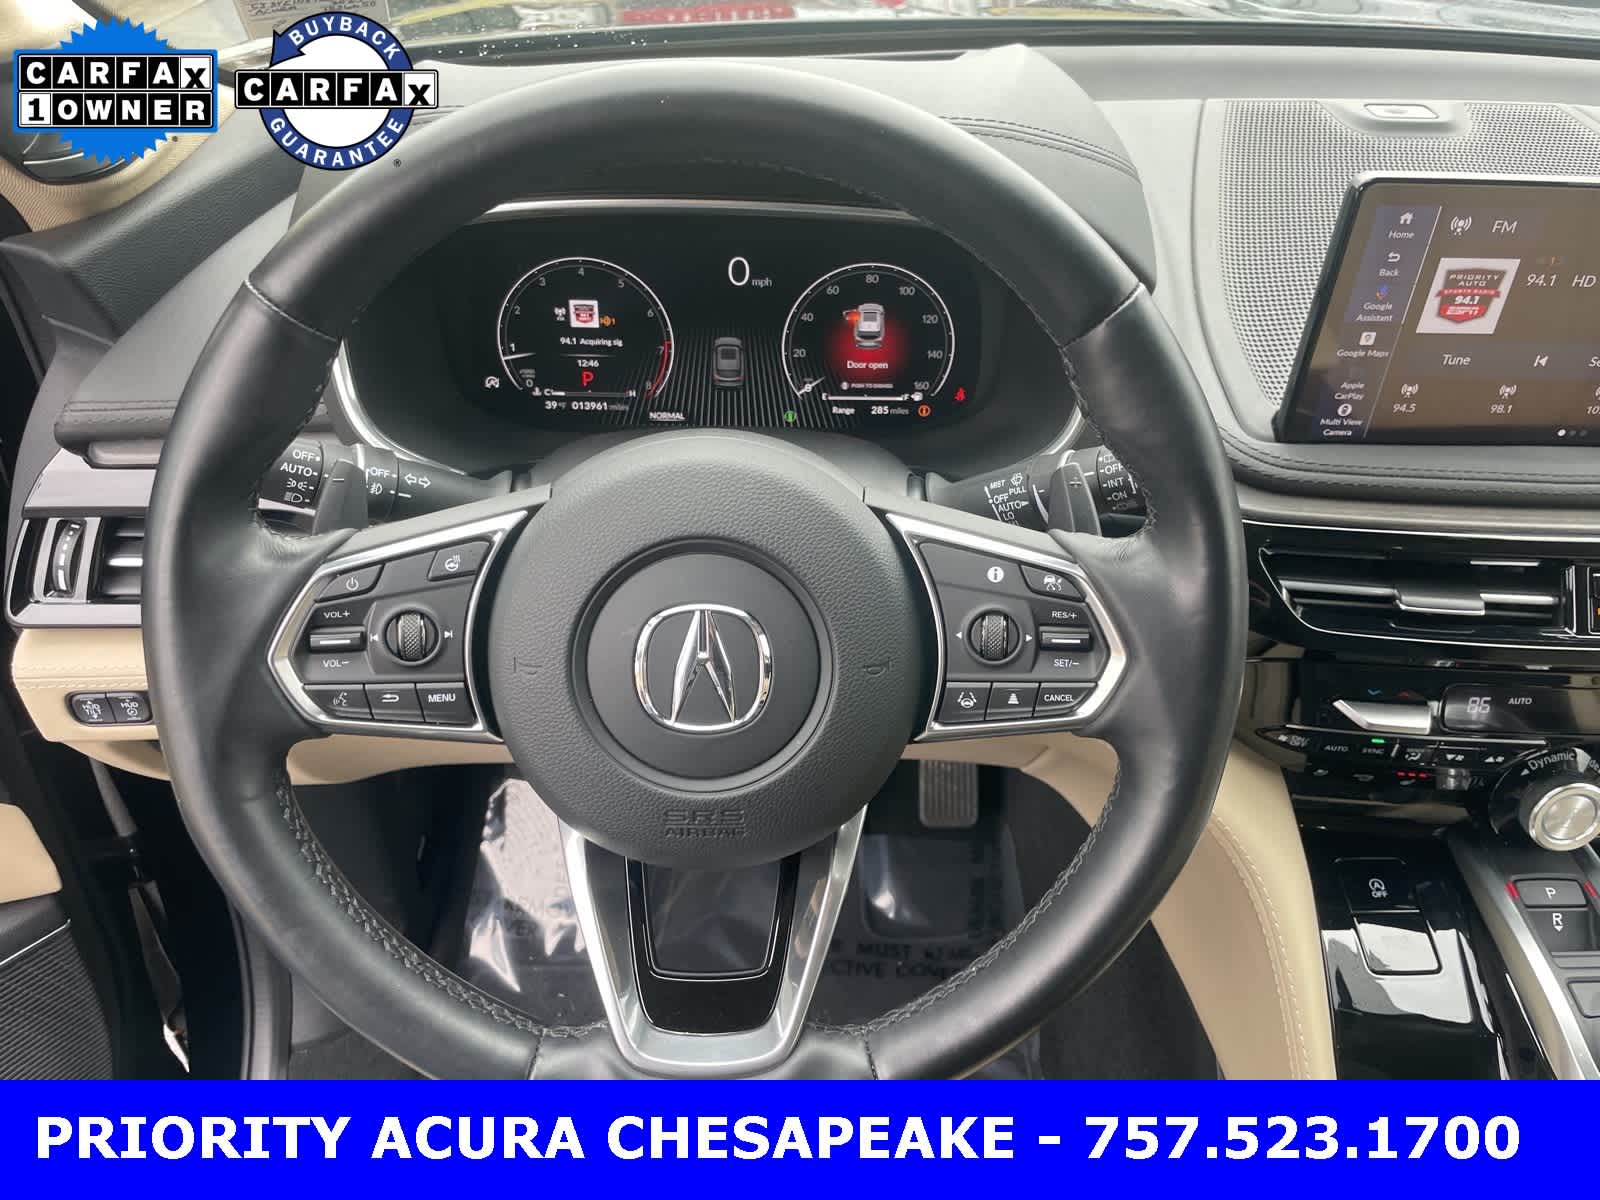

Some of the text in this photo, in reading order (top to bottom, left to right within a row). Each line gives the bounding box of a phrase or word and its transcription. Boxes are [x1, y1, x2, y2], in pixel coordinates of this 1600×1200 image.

[1492, 220, 1517, 234] FM
[1388, 230, 1415, 239] Home
[577, 267, 585, 277] 4
[728, 257, 772, 287] 0 mph
[1379, 268, 1400, 277] Back
[539, 278, 546, 287] 3
[617, 279, 625, 288] 5
[865, 274, 879, 284] 80
[1527, 274, 1597, 288] 94.1 HD
[827, 285, 840, 295] 60
[899, 287, 916, 296] 100
[1454, 295, 1480, 305] 94.1
[514, 306, 521, 315] 2
[1363, 302, 1393, 313] Google
[647, 309, 655, 318] 6
[801, 313, 814, 322] 40
[922, 314, 938, 324] 120
[1356, 315, 1393, 323] Assistant
[560, 337, 577, 345] 94.1
[580, 338, 612, 347] Acquiring
[509, 343, 515, 352] 1
[793, 349, 806, 358] 20
[927, 350, 943, 360] 140
[1337, 349, 1389, 358] Google Maps
[577, 359, 600, 368] 12:46
[847, 360, 889, 371] Door open
[1442, 354, 1471, 367] Tune
[581, 370, 594, 386] P
[525, 379, 534, 388] 0
[914, 381, 930, 391] 160
[1341, 382, 1365, 390] Apple
[1334, 392, 1365, 401] CarPlay
[544, 401, 558, 410] 39
[571, 401, 608, 411] 013961
[832, 406, 855, 416] Range
[871, 406, 909, 416] 285 miles
[1393, 403, 1416, 414] 94.5
[1490, 404, 1513, 414] 98.1
[649, 411, 685, 421] NORMAL
[1323, 428, 1352, 436] Camera
[292, 451, 315, 461] OFF
[280, 462, 312, 477] AUTO
[371, 467, 390, 478] OFF
[990, 480, 1006, 489] MIST
[1108, 478, 1124, 488] INT
[1009, 486, 1027, 496] PULL
[993, 493, 1009, 505] OFF
[1112, 492, 1128, 501] ON
[998, 501, 1023, 513] AUTO
[1003, 512, 1015, 521] LO
[428, 694, 456, 703] MENU
[1044, 693, 1074, 702] CANCEL
[1324, 744, 1349, 752] AUTO
[1528, 751, 1576, 771] Dynamic
[664, 810, 745, 825] SRS
[1371, 890, 1388, 898] OFF
[1545, 887, 1556, 899] P
[1552, 913, 1562, 925] R
